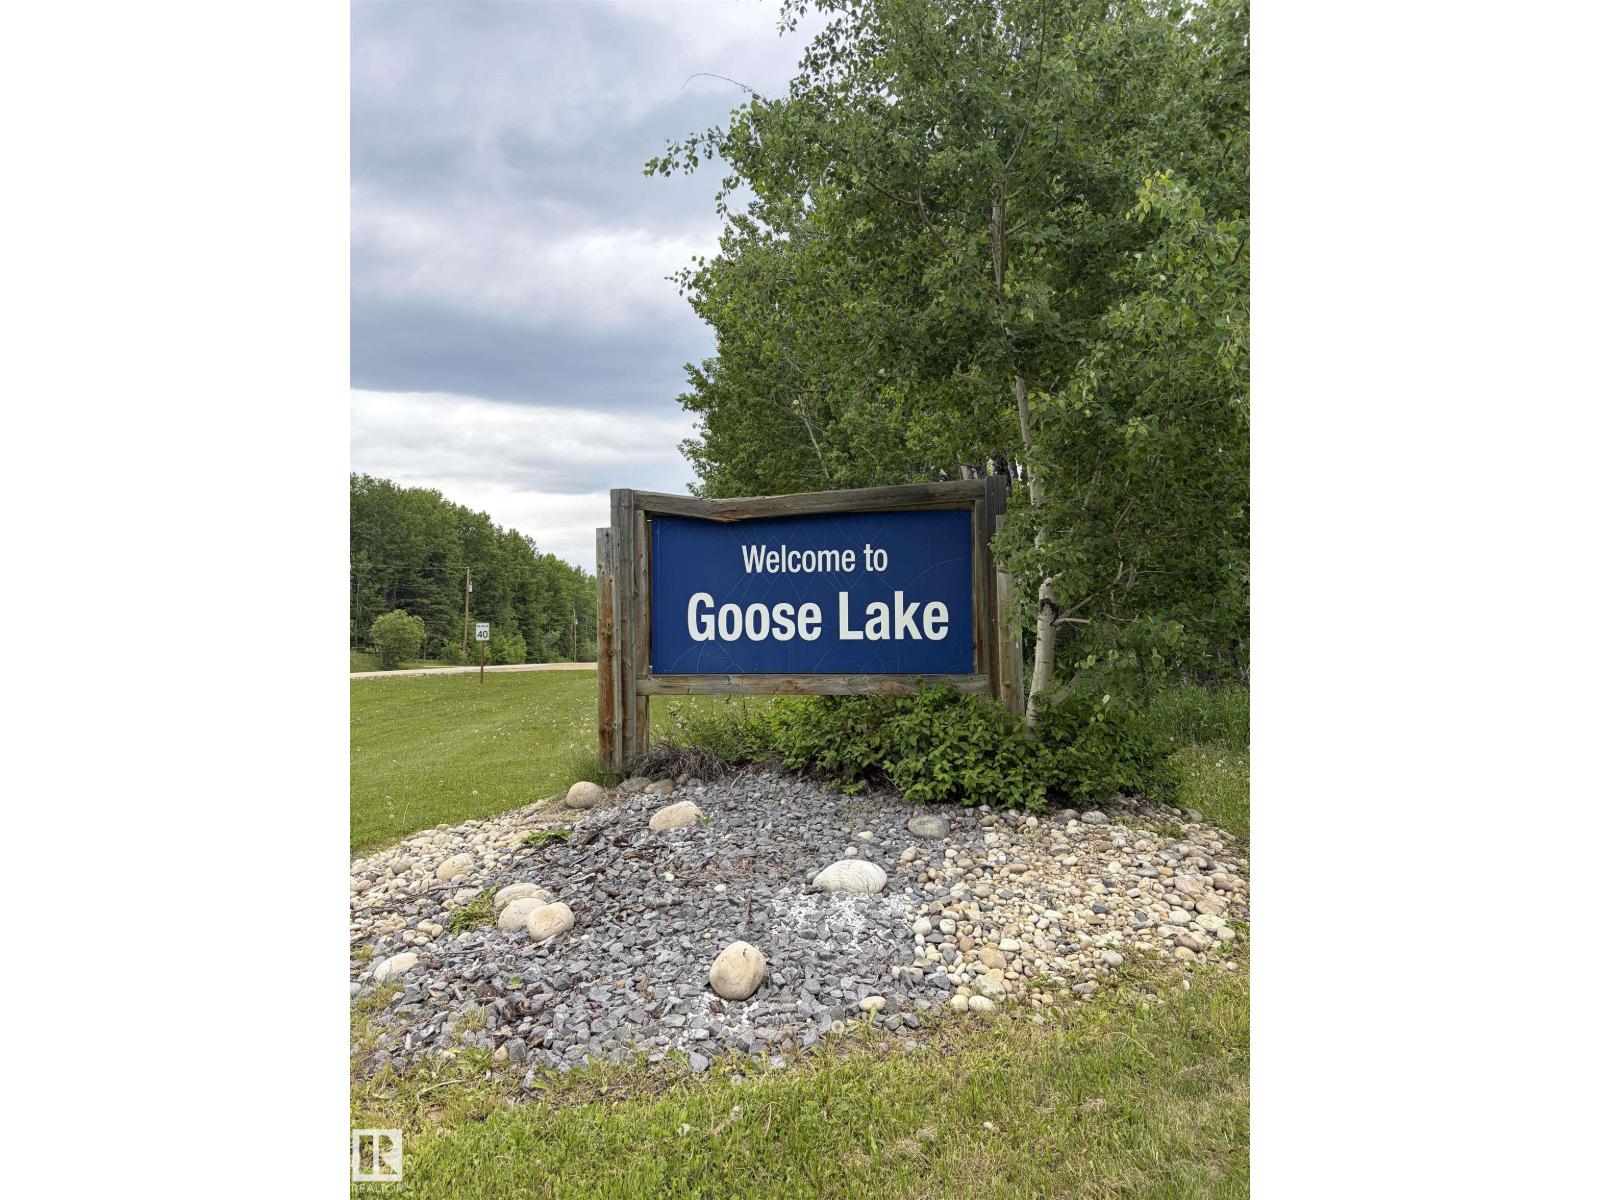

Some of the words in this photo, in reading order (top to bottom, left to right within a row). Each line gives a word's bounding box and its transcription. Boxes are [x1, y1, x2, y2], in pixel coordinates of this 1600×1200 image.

[741, 543, 857, 574] Welcome
[863, 543, 889, 573] to
[687, 591, 822, 643] Goose
[838, 590, 950, 641] Lake
[477, 630, 489, 639] 40
